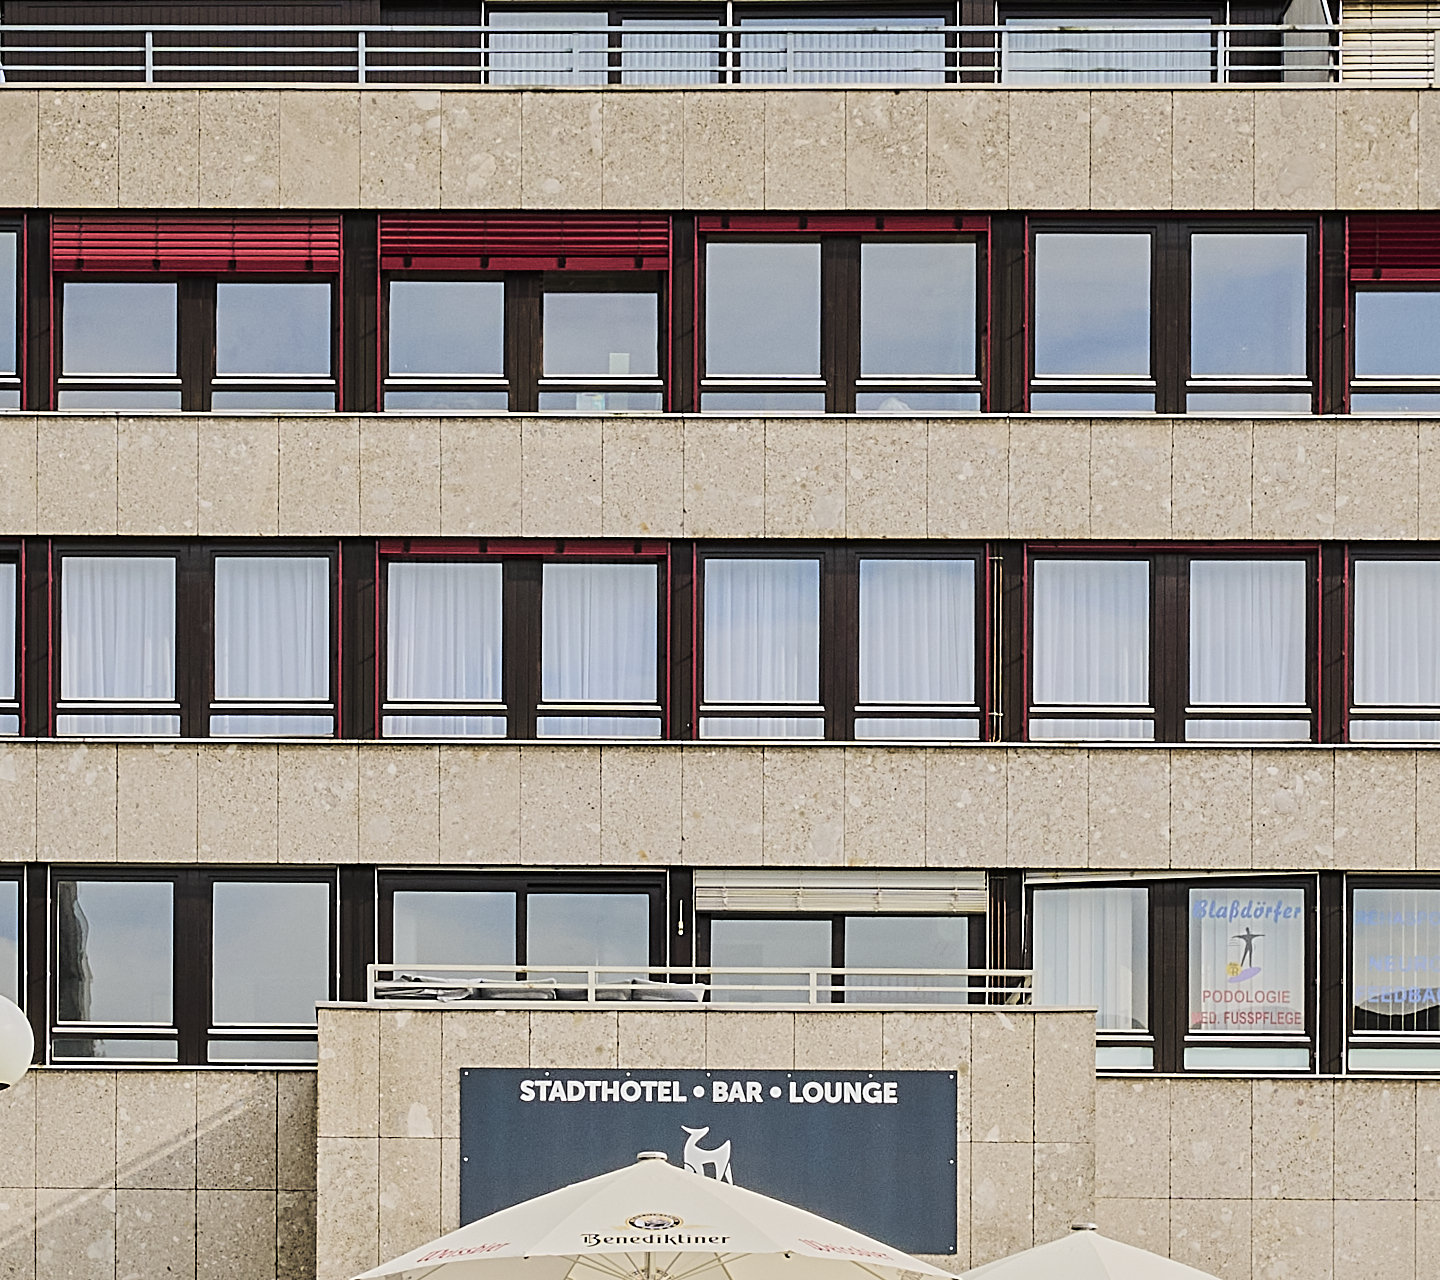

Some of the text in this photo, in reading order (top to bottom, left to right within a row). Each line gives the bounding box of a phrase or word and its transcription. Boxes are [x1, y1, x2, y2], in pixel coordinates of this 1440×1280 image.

[1193, 899, 1302, 924] Blaßdörfer
[1202, 990, 1290, 1004] PODOLOGIE
[1191, 1011, 1302, 1025] ED. FUSSPFLEGE
[519, 1080, 898, 1104] STADTHOTEL BAR LOUNGE
[580, 1233, 731, 1248] Benediktiner
